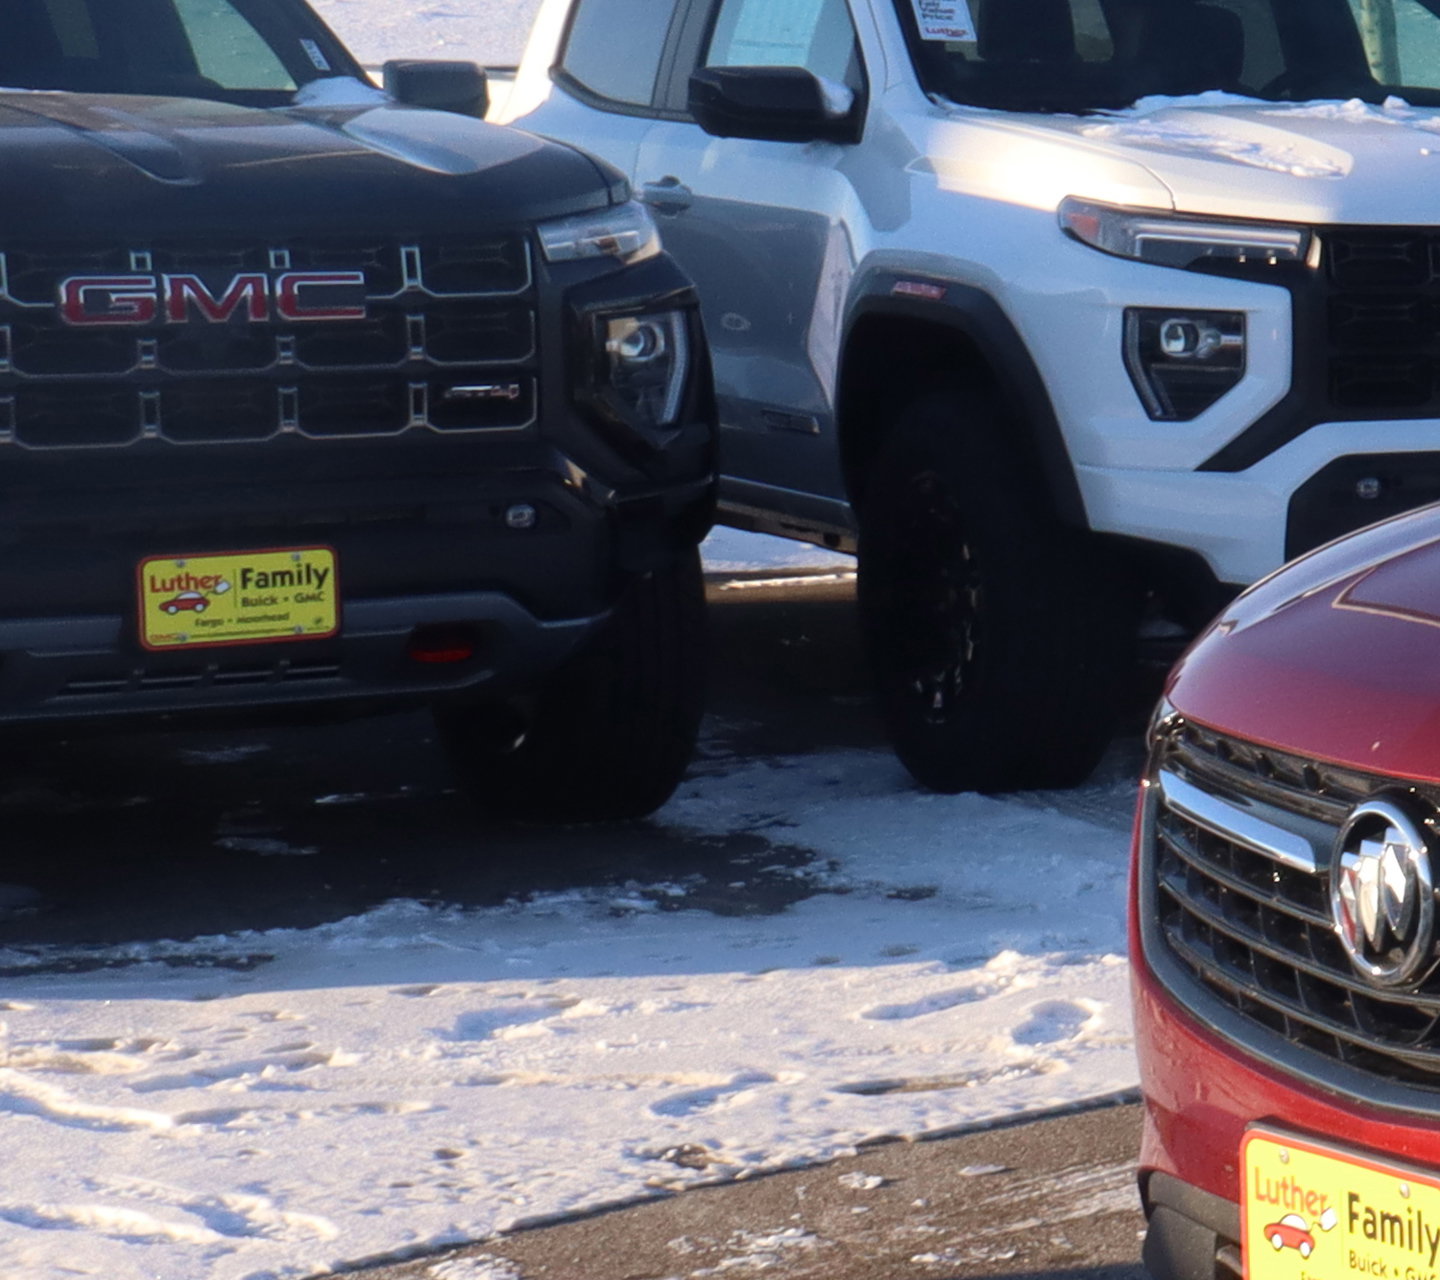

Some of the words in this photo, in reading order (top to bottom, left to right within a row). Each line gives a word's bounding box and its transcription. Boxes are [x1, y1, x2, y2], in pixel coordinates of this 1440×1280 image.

[51, 272, 366, 325] GMC
[151, 573, 223, 593] Luther
[241, 563, 330, 590] Family
[241, 594, 279, 608] Buick
[294, 591, 324, 604] GMC
[1255, 1167, 1328, 1217] Luther
[1349, 1250, 1388, 1278] Buick
